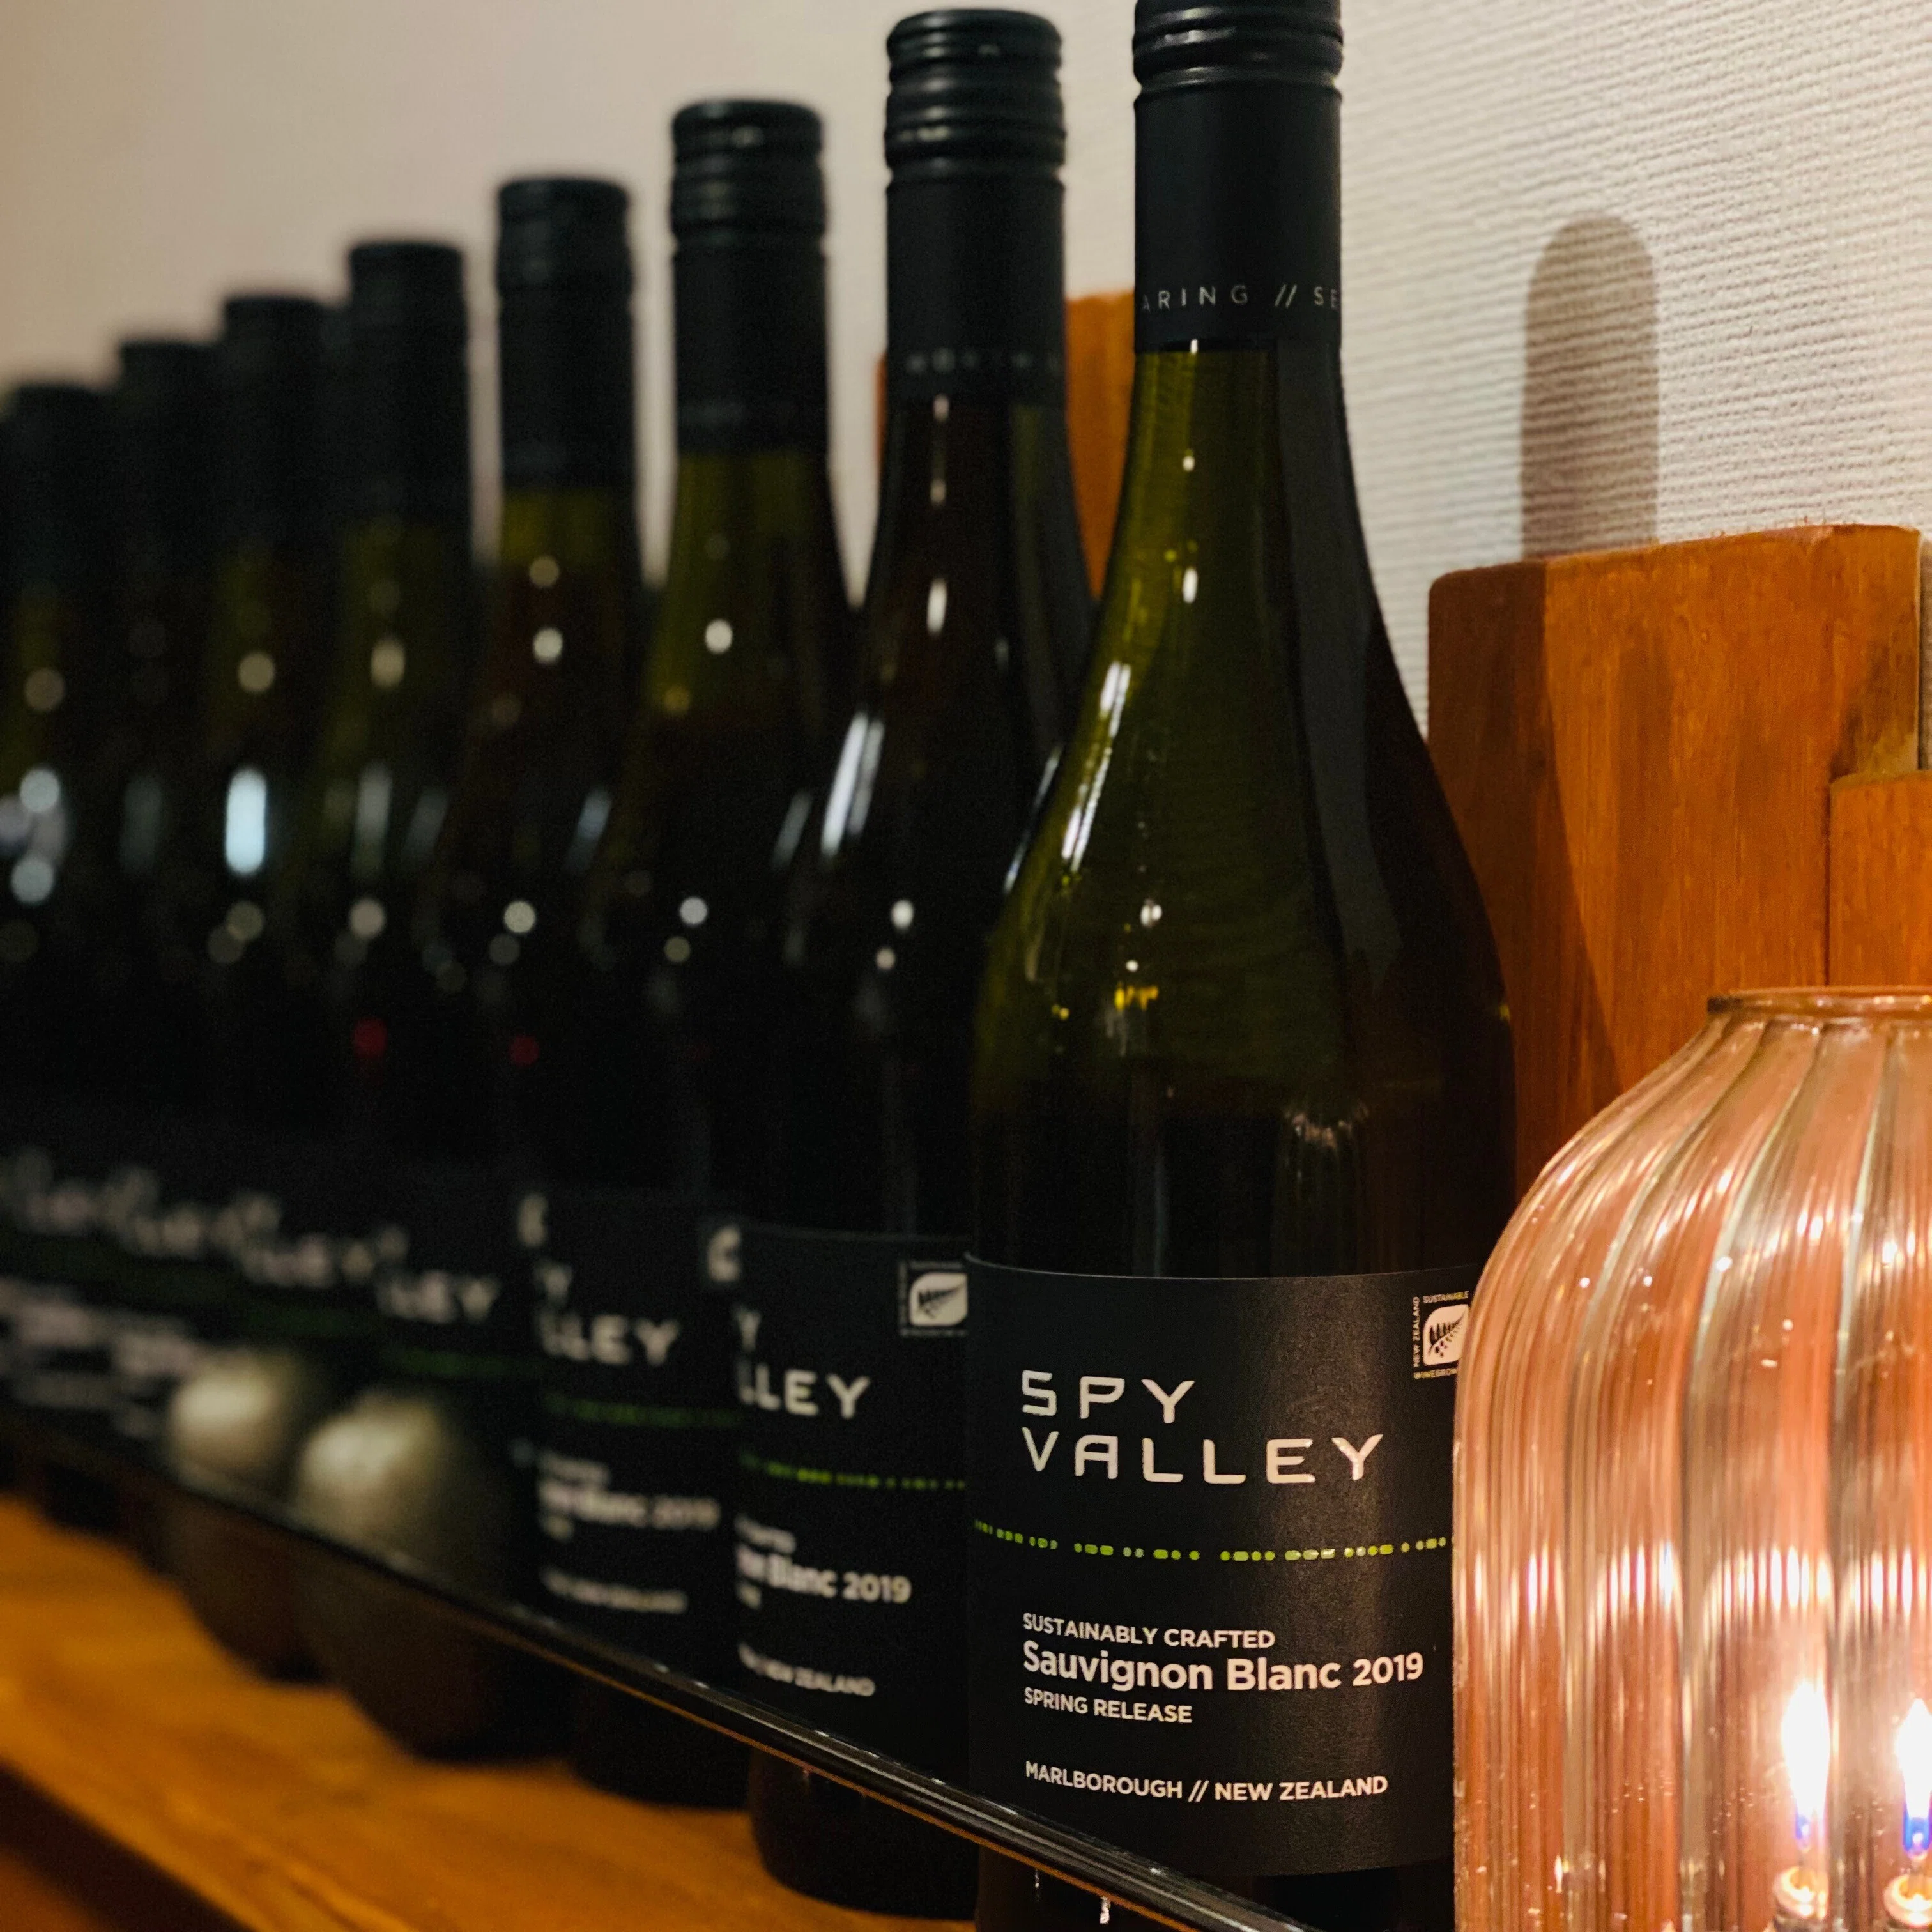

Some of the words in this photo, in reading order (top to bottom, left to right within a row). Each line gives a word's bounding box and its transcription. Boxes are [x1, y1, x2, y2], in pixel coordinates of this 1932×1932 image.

[1412, 1296, 1420, 1342] ZEALAND
[1022, 1370, 1195, 1424] SPY
[1022, 1427, 1384, 1484] VALLEY
[842, 1570, 912, 1604] 2019
[1023, 1612, 1158, 1645] SUSTAINABLY
[1163, 1629, 1276, 1648] CRAFTED
[1023, 1639, 1213, 1692] Sauvignon
[1227, 1657, 1342, 1691] Blanc
[1352, 1652, 1423, 1687] 2019
[1024, 1687, 1088, 1714] SPRING
[1093, 1698, 1193, 1723] RELEASE
[1025, 1761, 1183, 1798] MARLBOROUGH
[1188, 1780, 1210, 1802] //
[1215, 1782, 1273, 1801] NEW
[1278, 1775, 1388, 1800] ZEALAND
